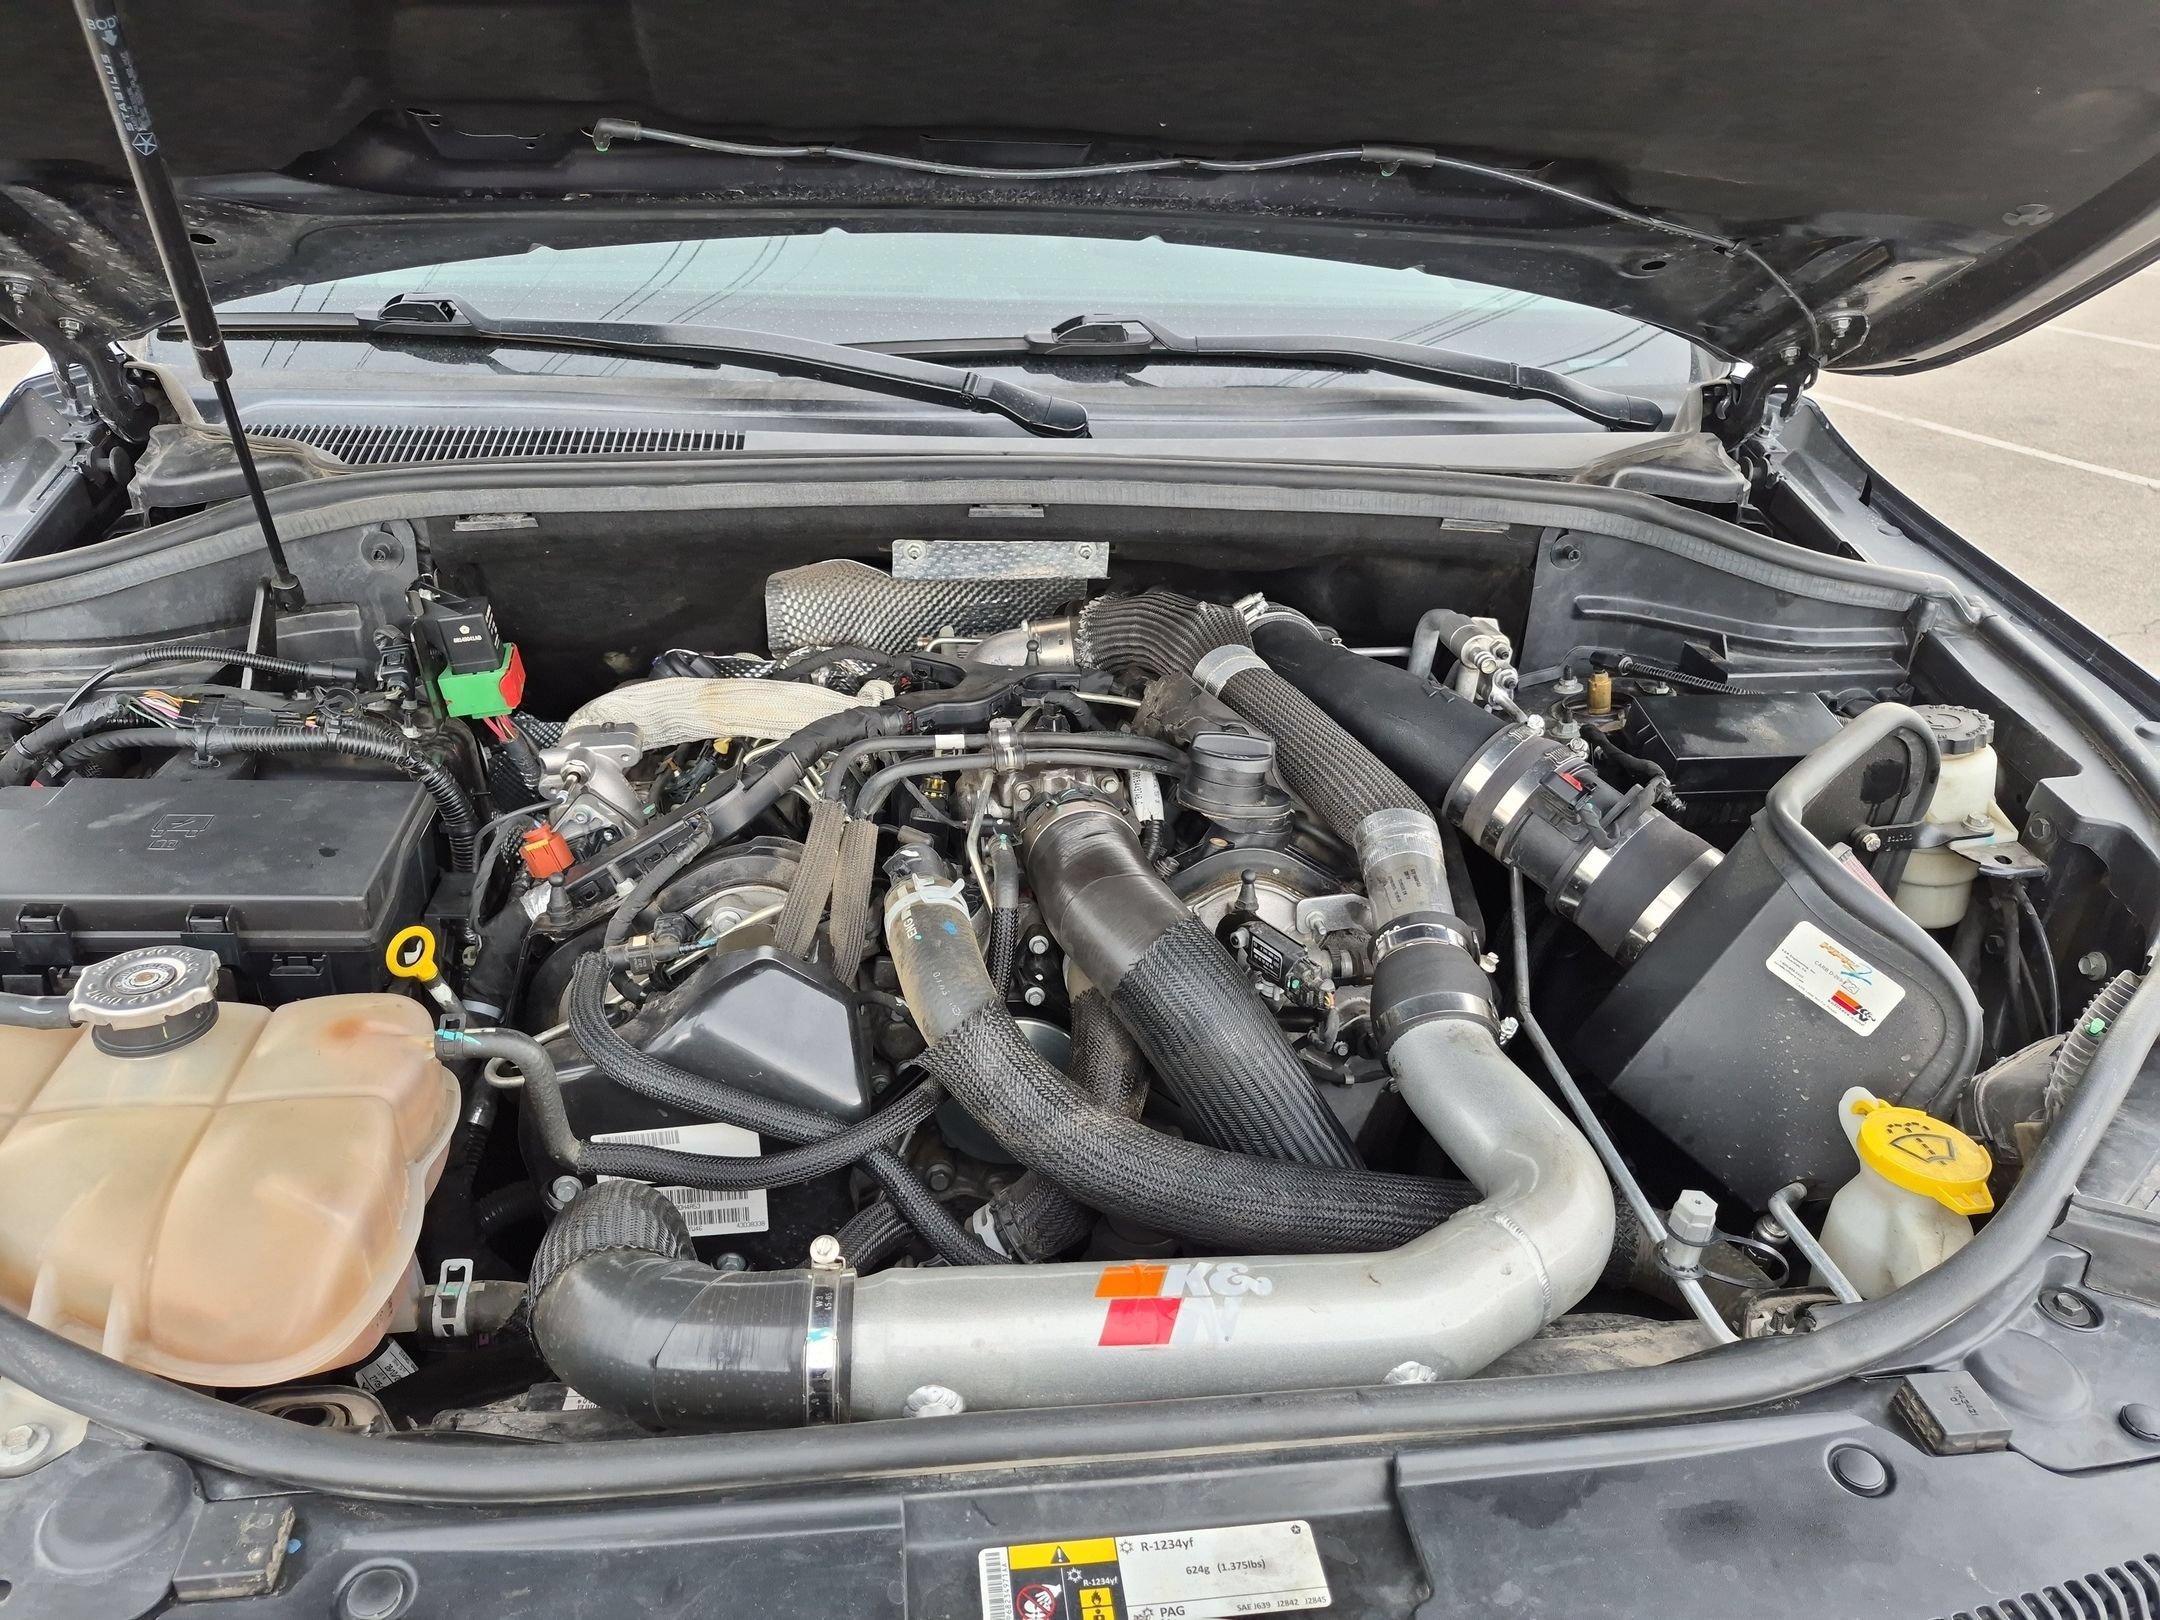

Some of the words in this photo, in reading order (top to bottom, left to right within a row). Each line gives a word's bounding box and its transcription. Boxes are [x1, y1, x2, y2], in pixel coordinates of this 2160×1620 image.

[101, 53, 135, 132] STABILUS
[1140, 1537, 1194, 1552] R-1234yf
[1186, 1564, 1211, 1576] 624g
[1217, 1559, 1266, 1573] (1.375lbs)
[1083, 1576, 1118, 1587] R-1234yf
[1160, 1605, 1186, 1617] PAG
[1254, 1602, 1271, 1611] J639
[1277, 1599, 1299, 1608] J2842
[1305, 1596, 1327, 1605] J2845
